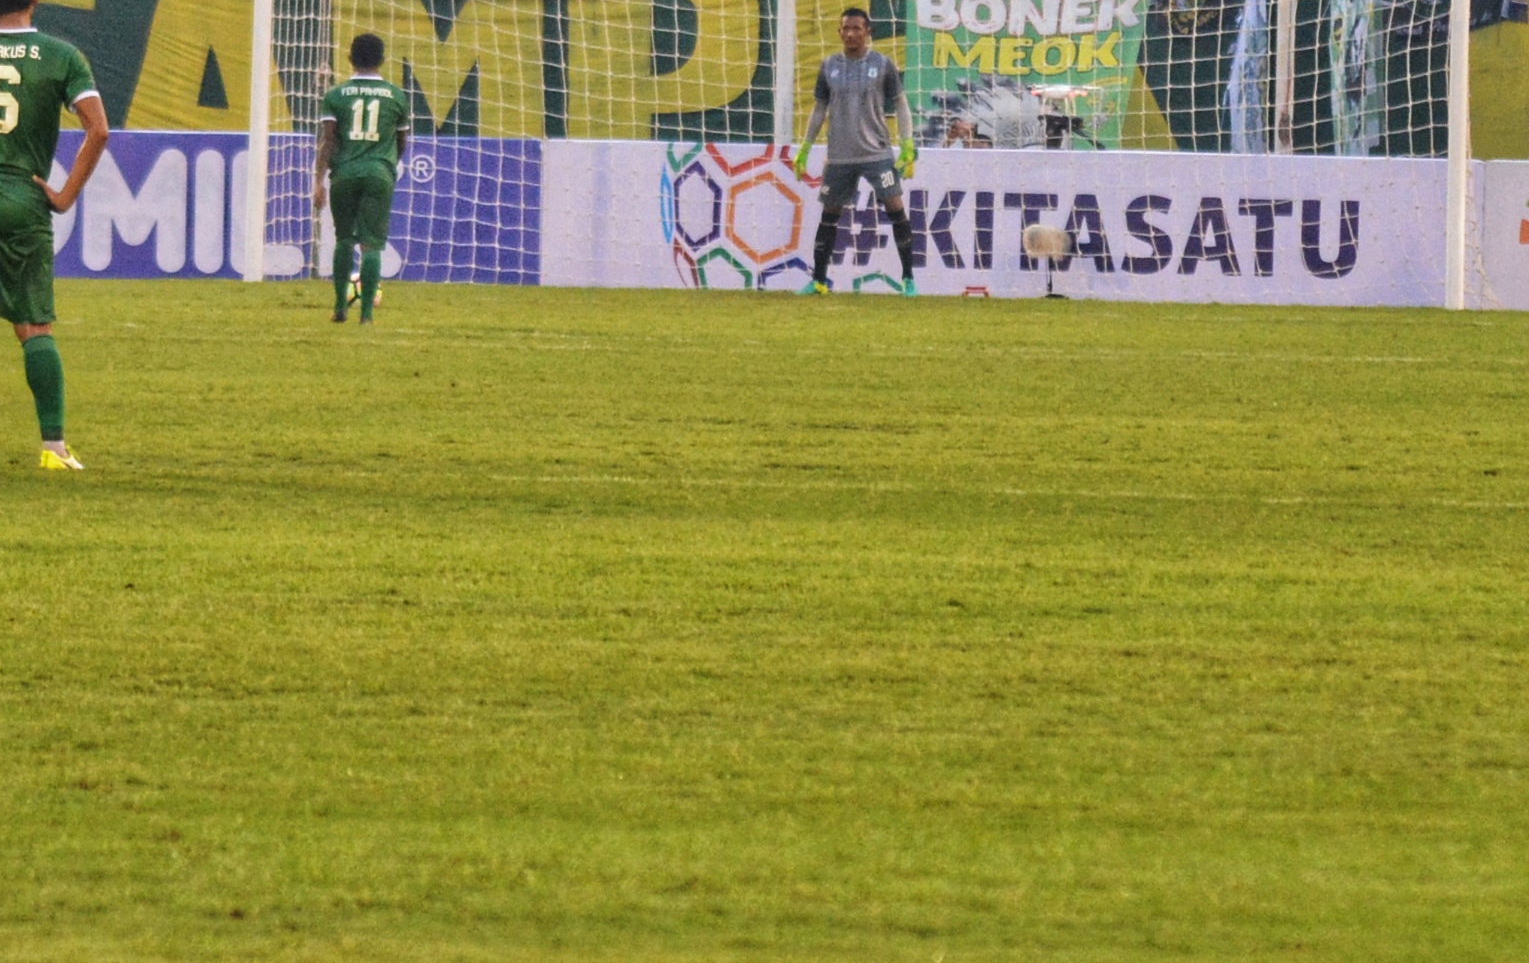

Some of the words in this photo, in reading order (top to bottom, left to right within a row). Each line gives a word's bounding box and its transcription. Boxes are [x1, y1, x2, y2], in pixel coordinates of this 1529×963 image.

[29, 45, 42, 60] S.
[932, 30, 1122, 76] MEOK
[349, 98, 380, 142] 11
[829, 187, 1361, 280] #KITASATU
